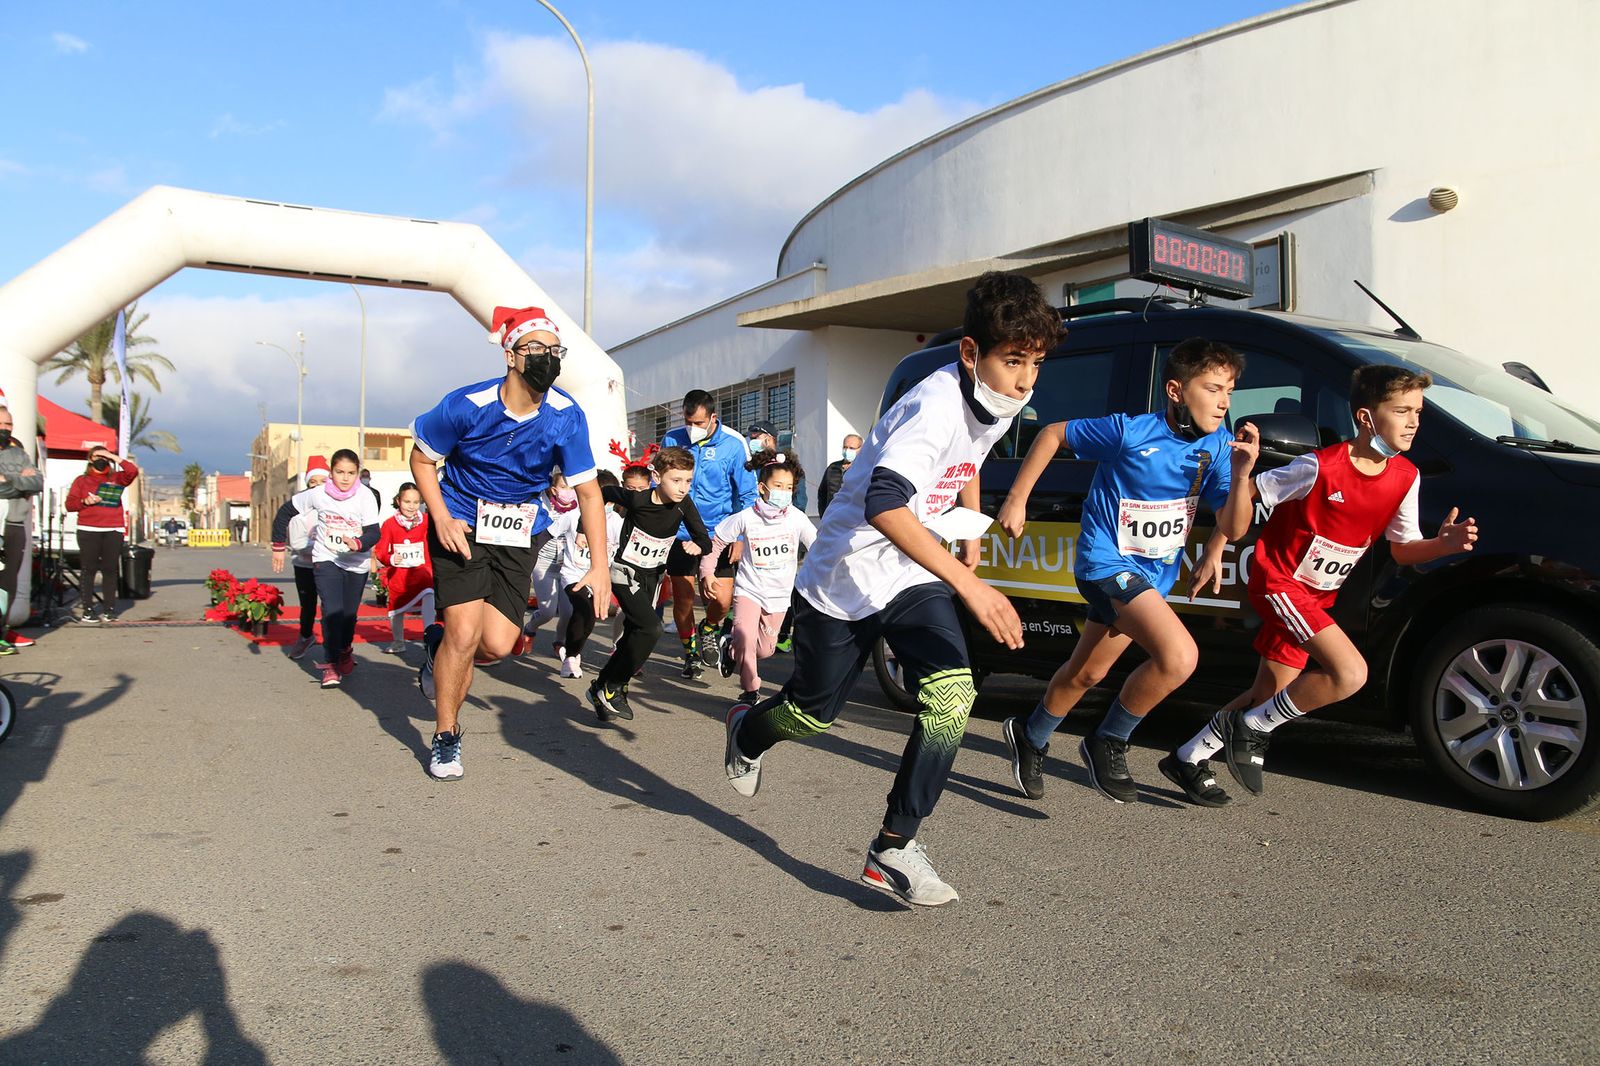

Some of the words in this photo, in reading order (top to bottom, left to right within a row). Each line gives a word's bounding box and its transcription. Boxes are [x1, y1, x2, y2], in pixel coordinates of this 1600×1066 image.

[955, 462, 977, 477] SAN
[482, 513, 524, 530] 1006
[1127, 517, 1184, 538] 1005
[755, 543, 789, 557] 1016
[1322, 541, 1334, 549] SAN
[398, 550, 421, 560] 017
[1029, 621, 1042, 632] en
[1043, 620, 1072, 636] Syrsa
